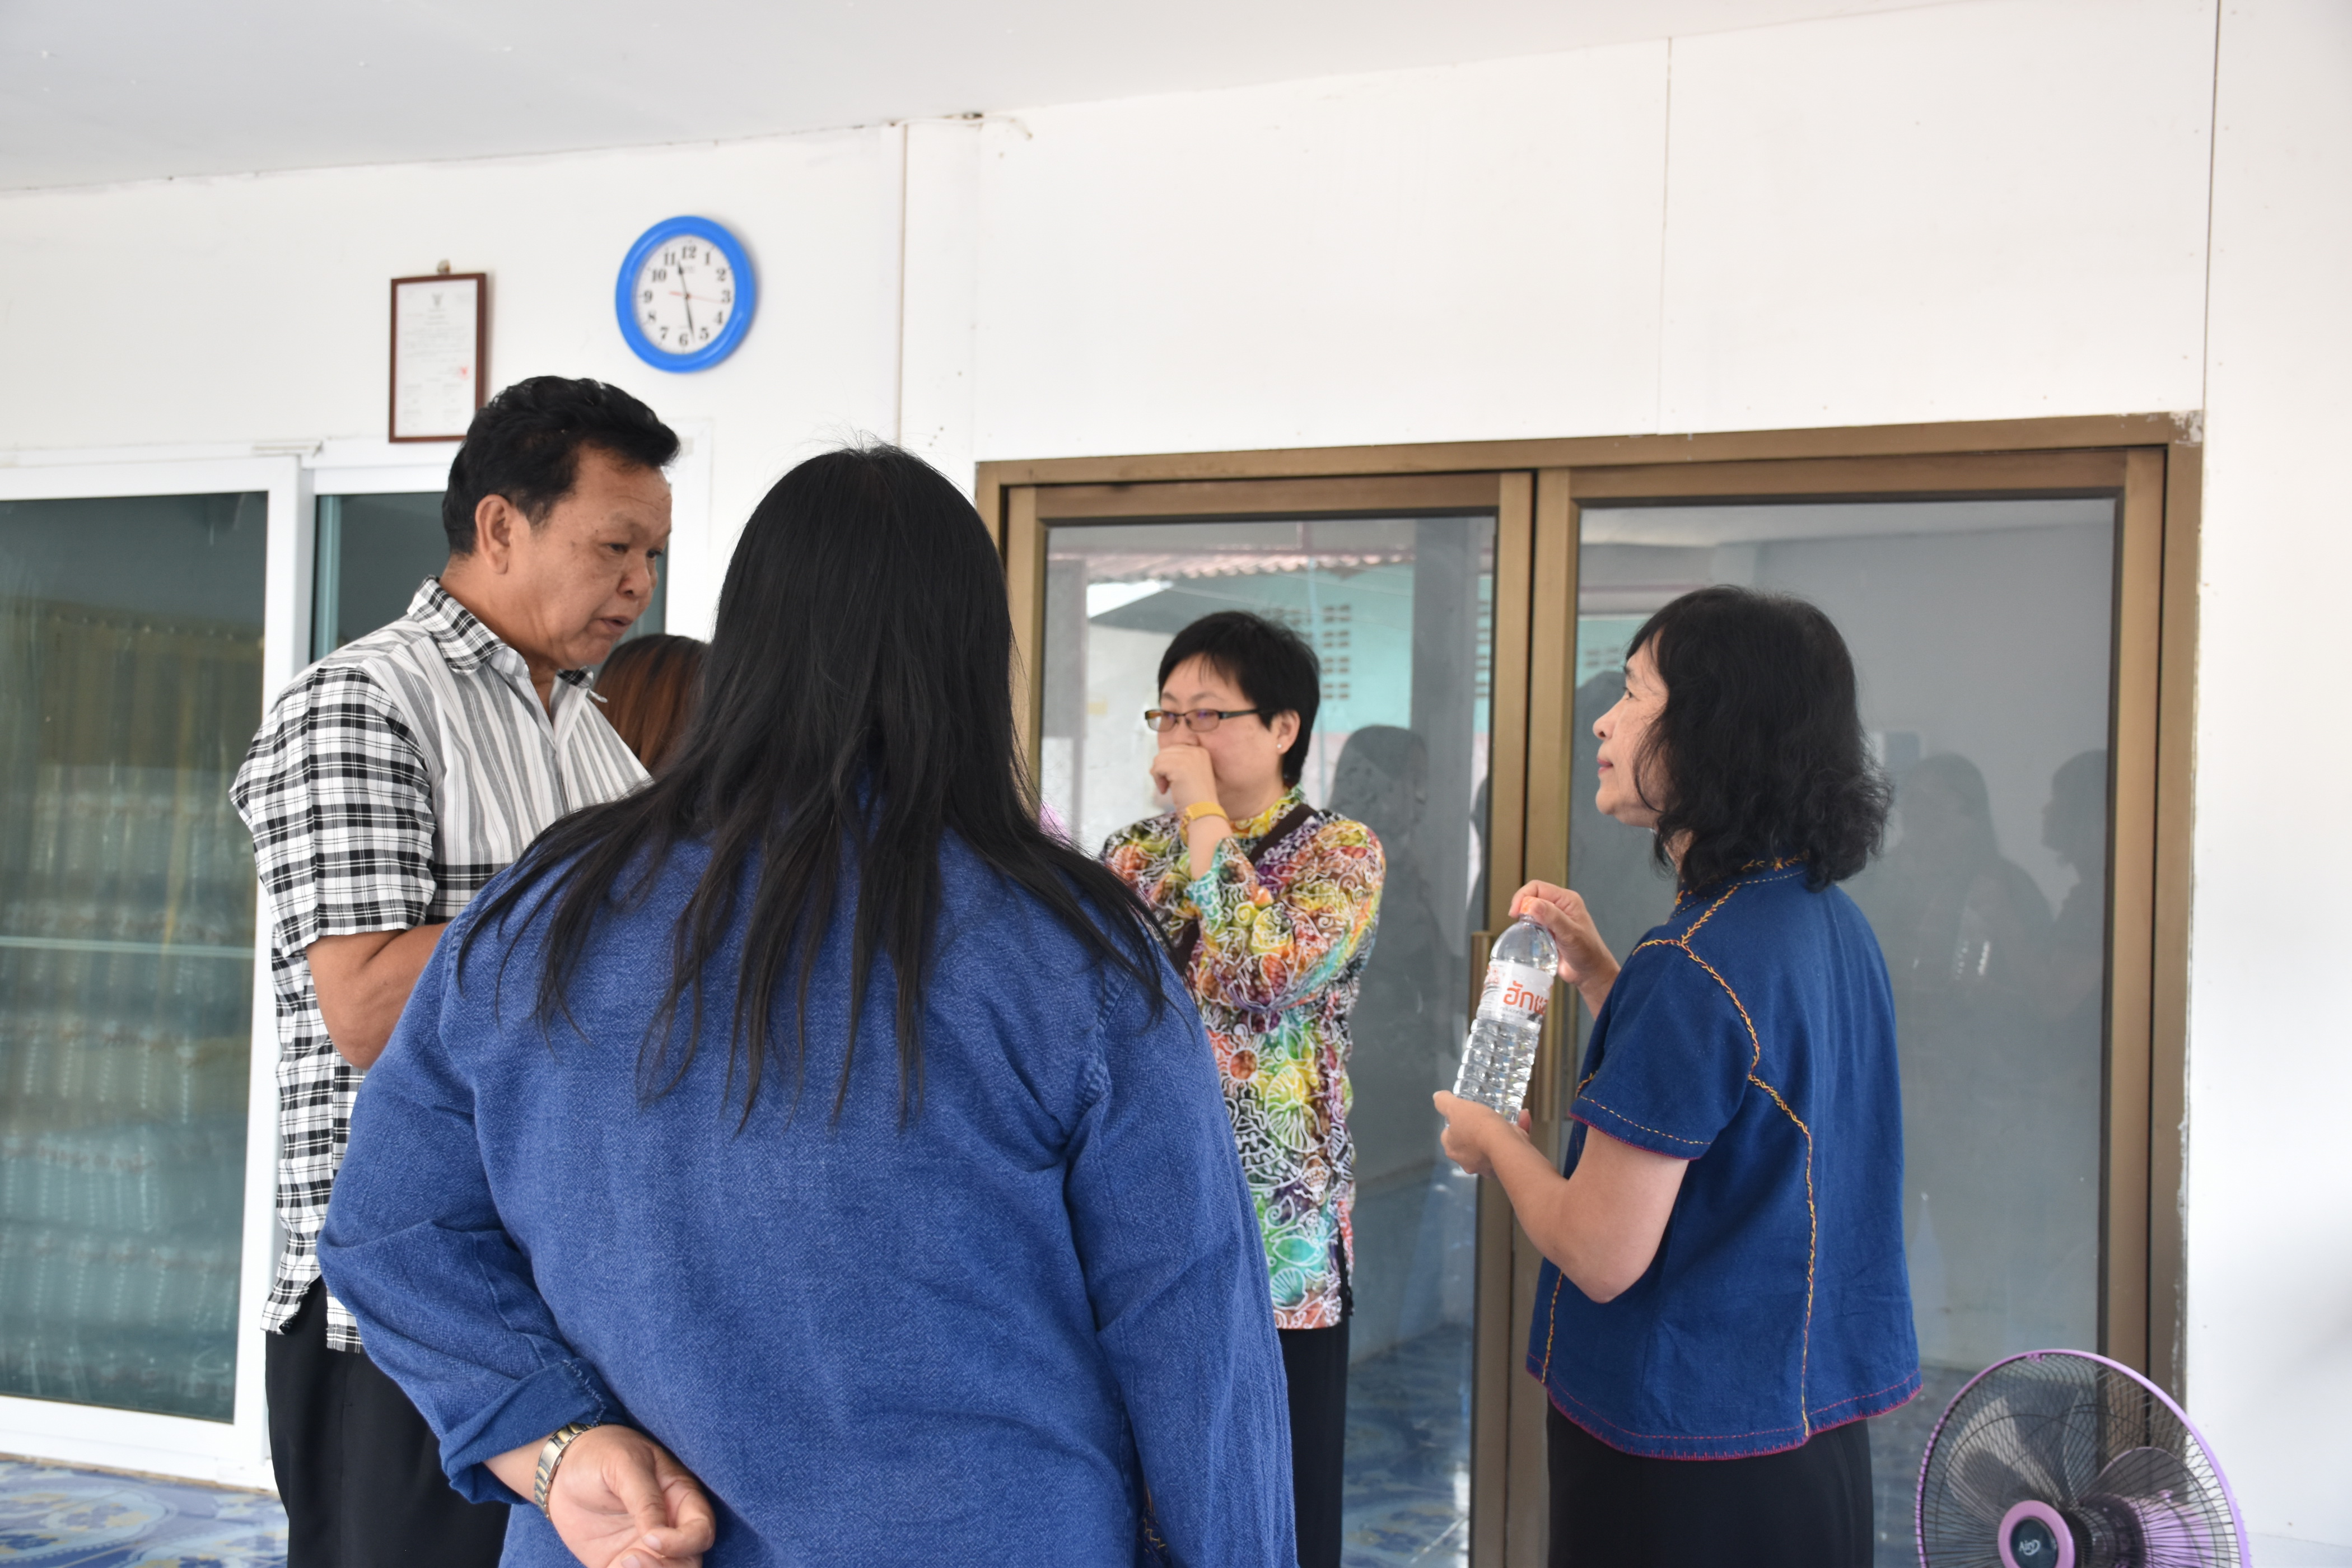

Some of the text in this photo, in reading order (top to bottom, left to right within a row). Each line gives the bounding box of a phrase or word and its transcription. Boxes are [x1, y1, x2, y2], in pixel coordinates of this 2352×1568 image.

[664, 252, 675, 266] 11
[682, 245, 697, 259] 12
[705, 251, 711, 265] 1
[652, 269, 667, 283] 10
[717, 268, 726, 282] 2
[644, 290, 653, 303] 9
[721, 290, 731, 304] 3
[648, 310, 656, 323] 8
[715, 310, 723, 325] 4
[660, 326, 669, 339] 7
[699, 327, 710, 340] 5
[679, 333, 688, 347] 6
